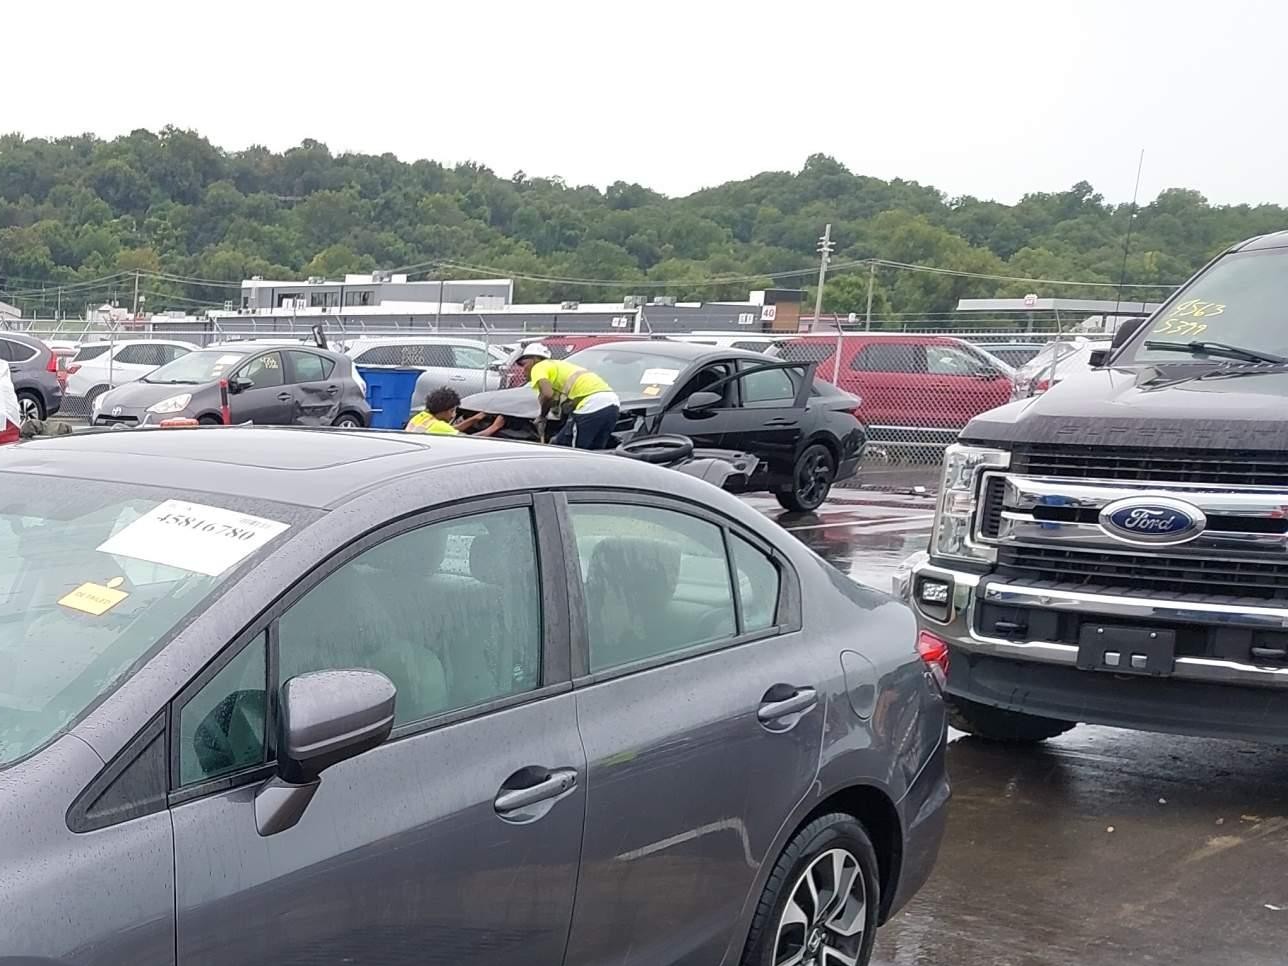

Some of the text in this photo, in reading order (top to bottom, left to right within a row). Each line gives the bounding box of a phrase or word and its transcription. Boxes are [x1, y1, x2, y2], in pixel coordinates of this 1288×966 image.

[763, 308, 775, 318] 40
[157, 512, 256, 542] 45816780
[1124, 508, 1176, 530] Ford
